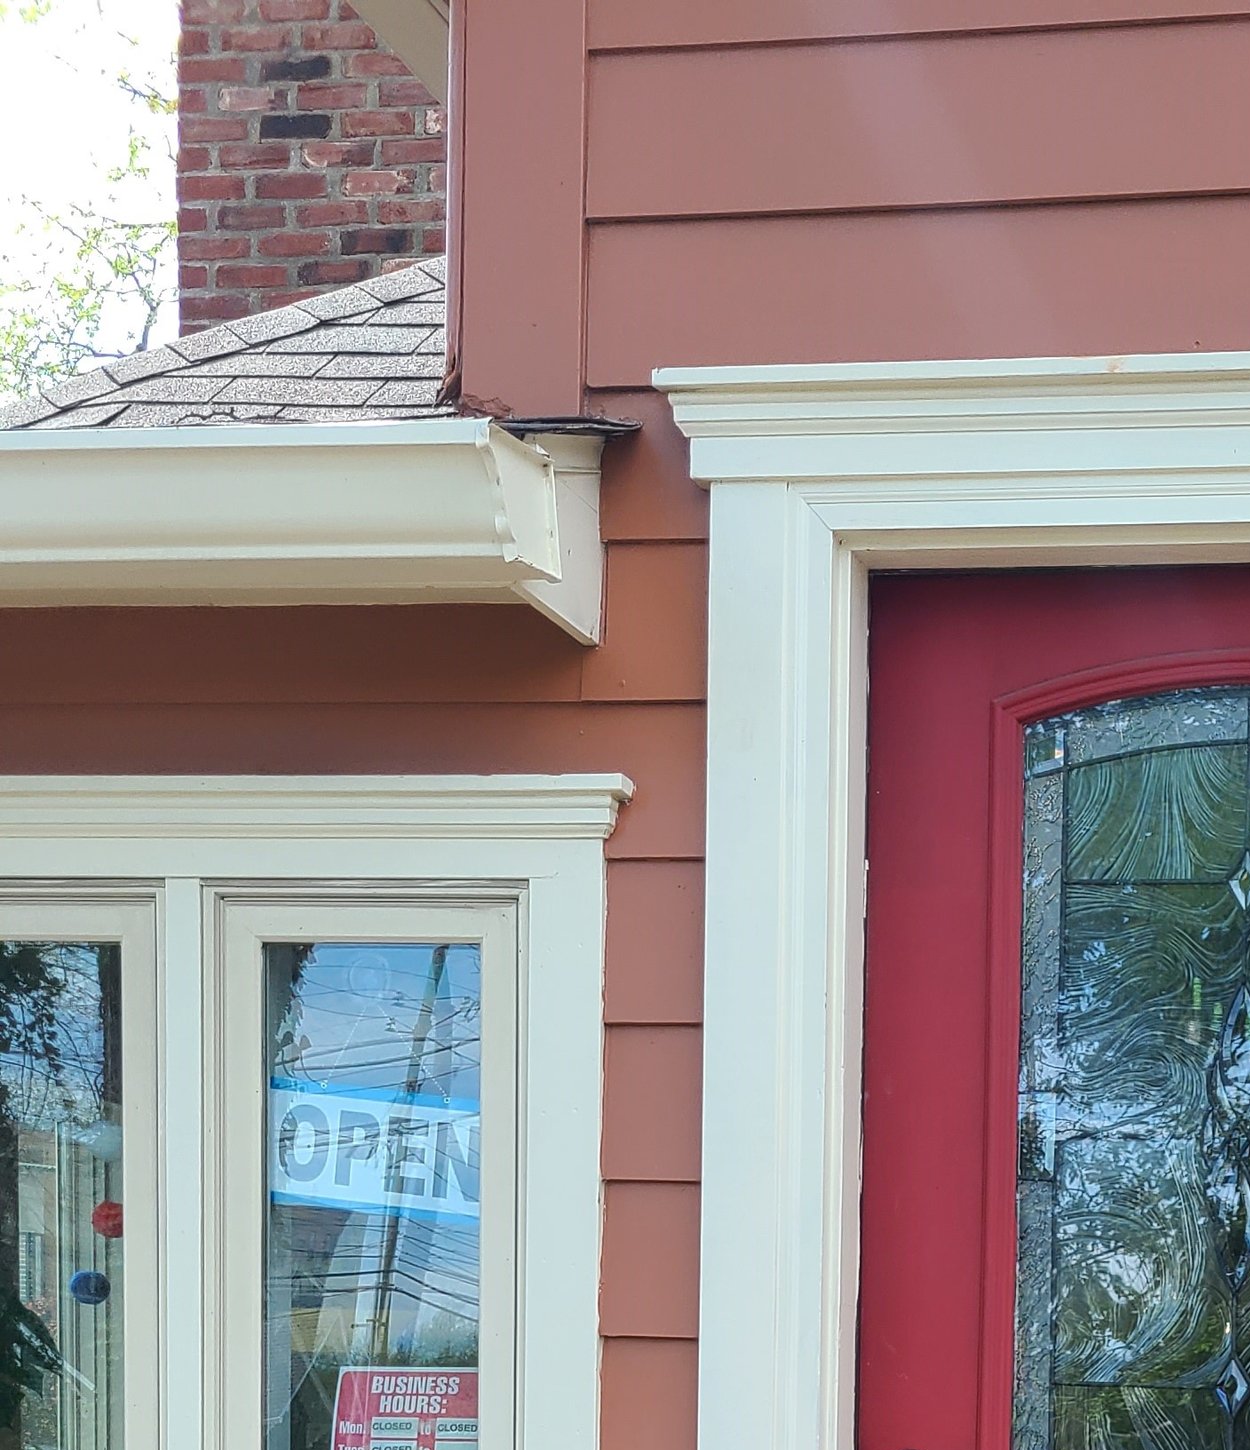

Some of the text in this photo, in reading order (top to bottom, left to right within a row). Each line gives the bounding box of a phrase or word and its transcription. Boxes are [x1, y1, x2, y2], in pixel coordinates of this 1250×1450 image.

[278, 1104, 480, 1203] OPEN
[371, 1375, 460, 1396] BUSINESS
[378, 1395, 448, 1414] HOURS:
[338, 1420, 478, 1436] Mon. CLOSED to CLOSED
